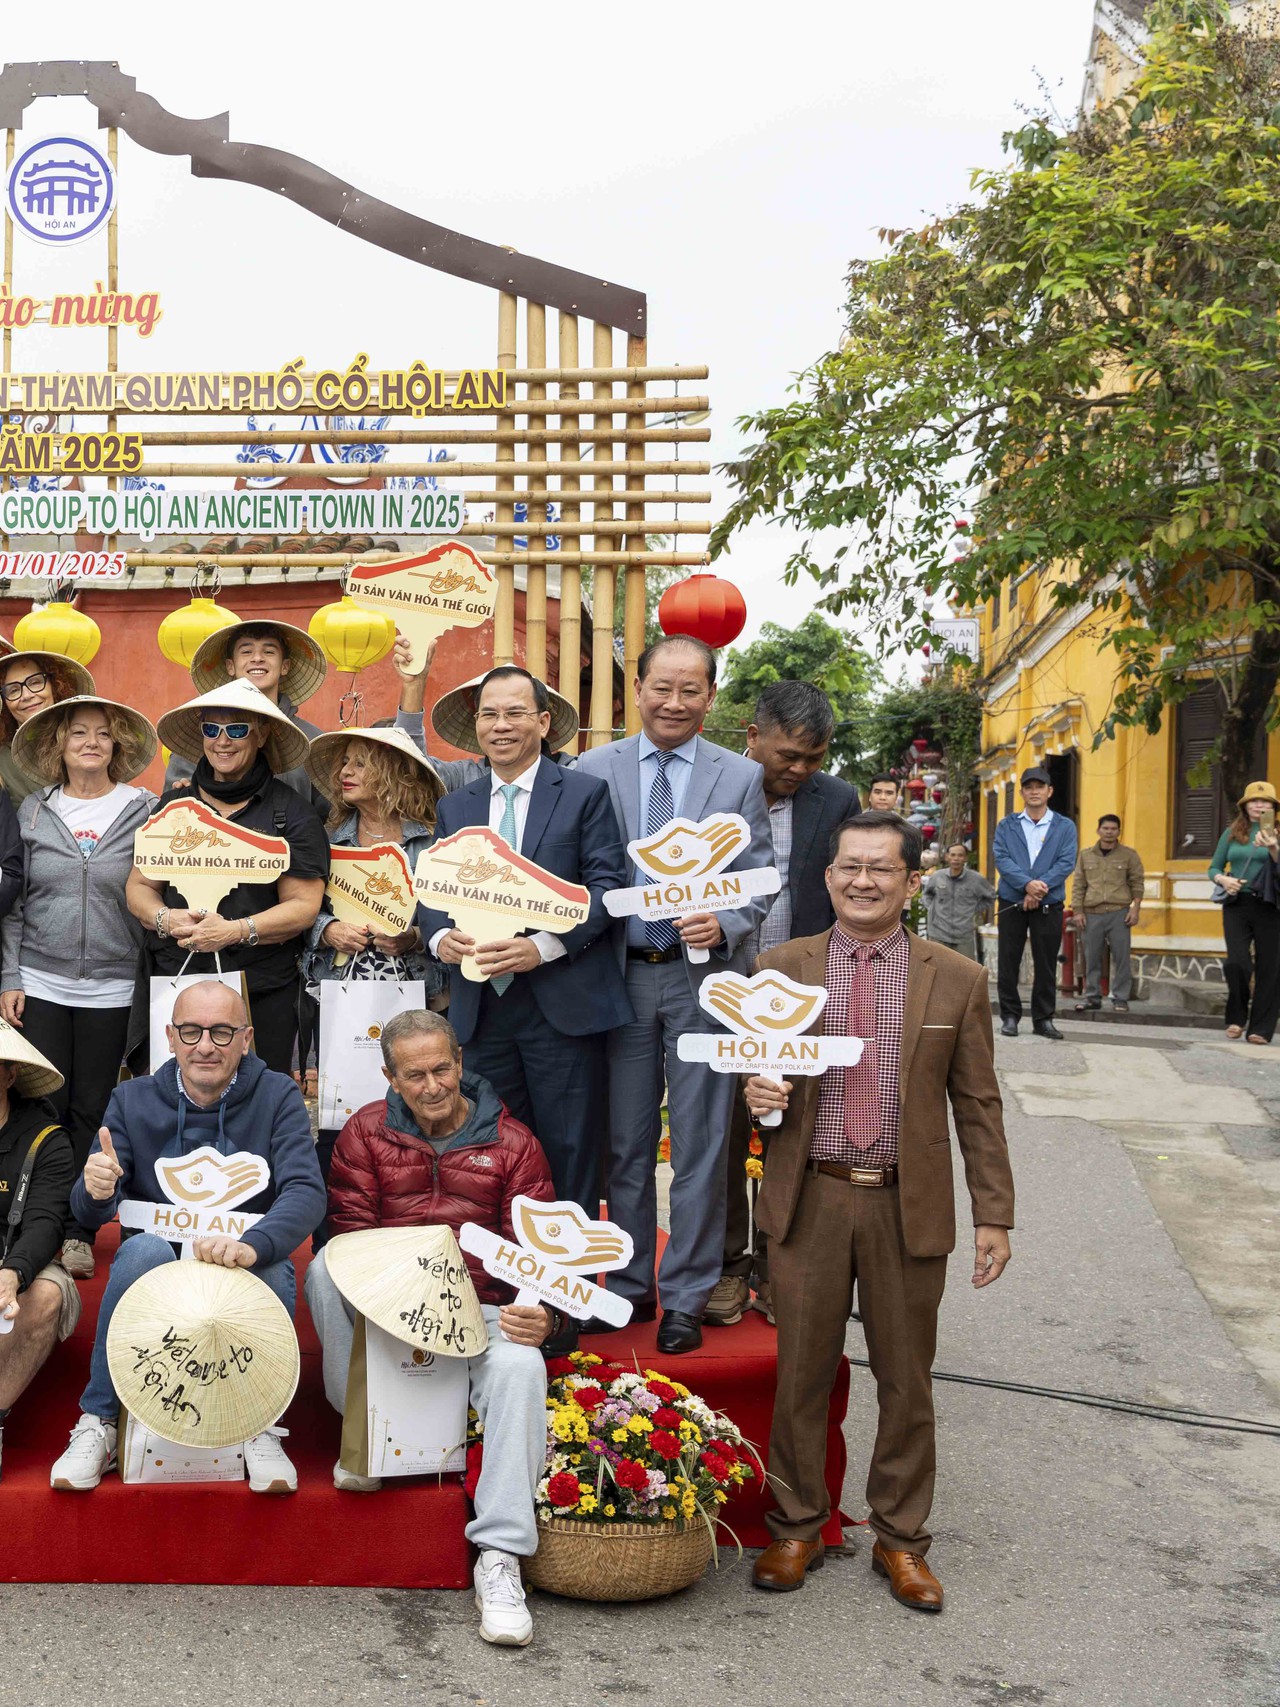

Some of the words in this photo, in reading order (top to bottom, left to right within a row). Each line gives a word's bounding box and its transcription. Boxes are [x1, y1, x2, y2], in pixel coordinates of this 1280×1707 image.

[45, 219, 60, 229] HỘI
[51, 282, 162, 336] mừng
[22, 375, 112, 408] THAM
[125, 375, 219, 408] QUAN
[234, 359, 303, 408] PHỐ
[316, 355, 368, 407] CỔ
[383, 363, 441, 416] HỘI
[456, 371, 504, 405] AN
[64, 436, 141, 468] 2025
[3, 495, 81, 529] GROUP
[88, 495, 117, 529] TO
[124, 492, 161, 537] HỘI
[167, 495, 198, 528] AN
[204, 495, 302, 528] ANCIENT
[309, 495, 374, 528] TOWN
[382, 495, 402, 528] IN
[410, 494, 460, 528] 2025
[350, 583, 360, 593] DI
[364, 584, 386, 598] SẢN
[389, 588, 411, 602] VĂN
[414, 594, 438, 607] HÓA
[442, 599, 464, 611] THẾ
[466, 603, 491, 616] GIỚI
[959, 629, 973, 637] AN
[136, 856, 146, 865] DI
[151, 854, 173, 866] SẢN
[178, 857, 201, 866] VĂN
[205, 856, 230, 867] HÓA
[234, 856, 256, 868] THẾ
[259, 859, 285, 869] GIỚI
[334, 876, 351, 893] VĂN
[352, 888, 369, 906] HÓA
[371, 900, 389, 916] THẾ
[388, 913, 407, 930] GIỚI
[416, 878, 429, 889] DI
[432, 880, 458, 895] SẢN
[462, 888, 490, 901] VĂN
[493, 893, 521, 908] HÓA
[527, 900, 552, 913] THẾ
[554, 905, 584, 919] GIỚI
[643, 883, 692, 907] HỘI
[703, 878, 741, 898] AN
[718, 1036, 766, 1061] HỘI
[777, 1042, 818, 1060] AN
[154, 1207, 199, 1231] HỘI
[207, 1216, 244, 1235] AN
[494, 1266, 507, 1276] CITY
[508, 1272, 516, 1280] OF
[516, 1276, 539, 1292] CRAFTS
[540, 1289, 552, 1299] AND
[553, 1295, 569, 1307] FOLK
[569, 1304, 581, 1313] ART
[495, 1245, 546, 1281] HỘI
[550, 1275, 593, 1305] AN
